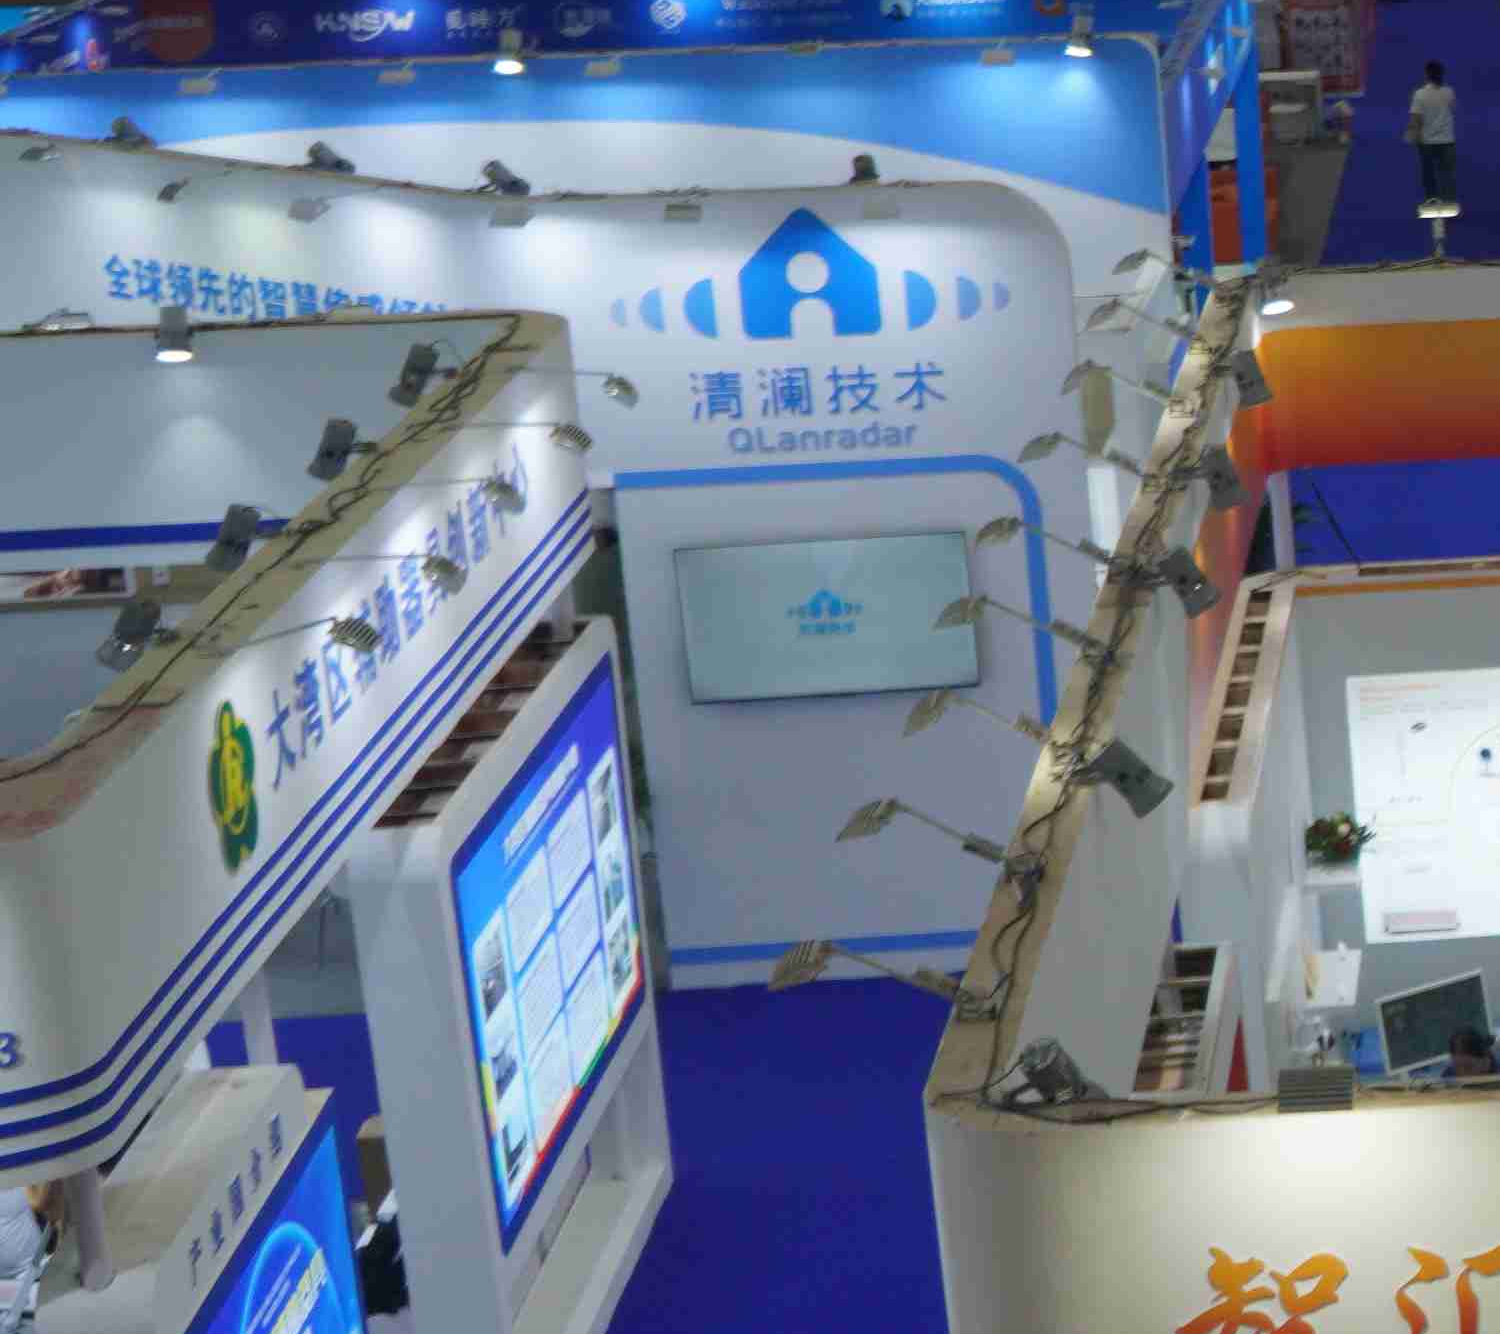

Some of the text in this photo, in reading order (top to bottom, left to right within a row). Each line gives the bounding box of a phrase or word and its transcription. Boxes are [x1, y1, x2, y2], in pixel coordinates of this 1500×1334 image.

[688, 361, 947, 420] 清澜技术
[728, 422, 919, 455] QLanradar
